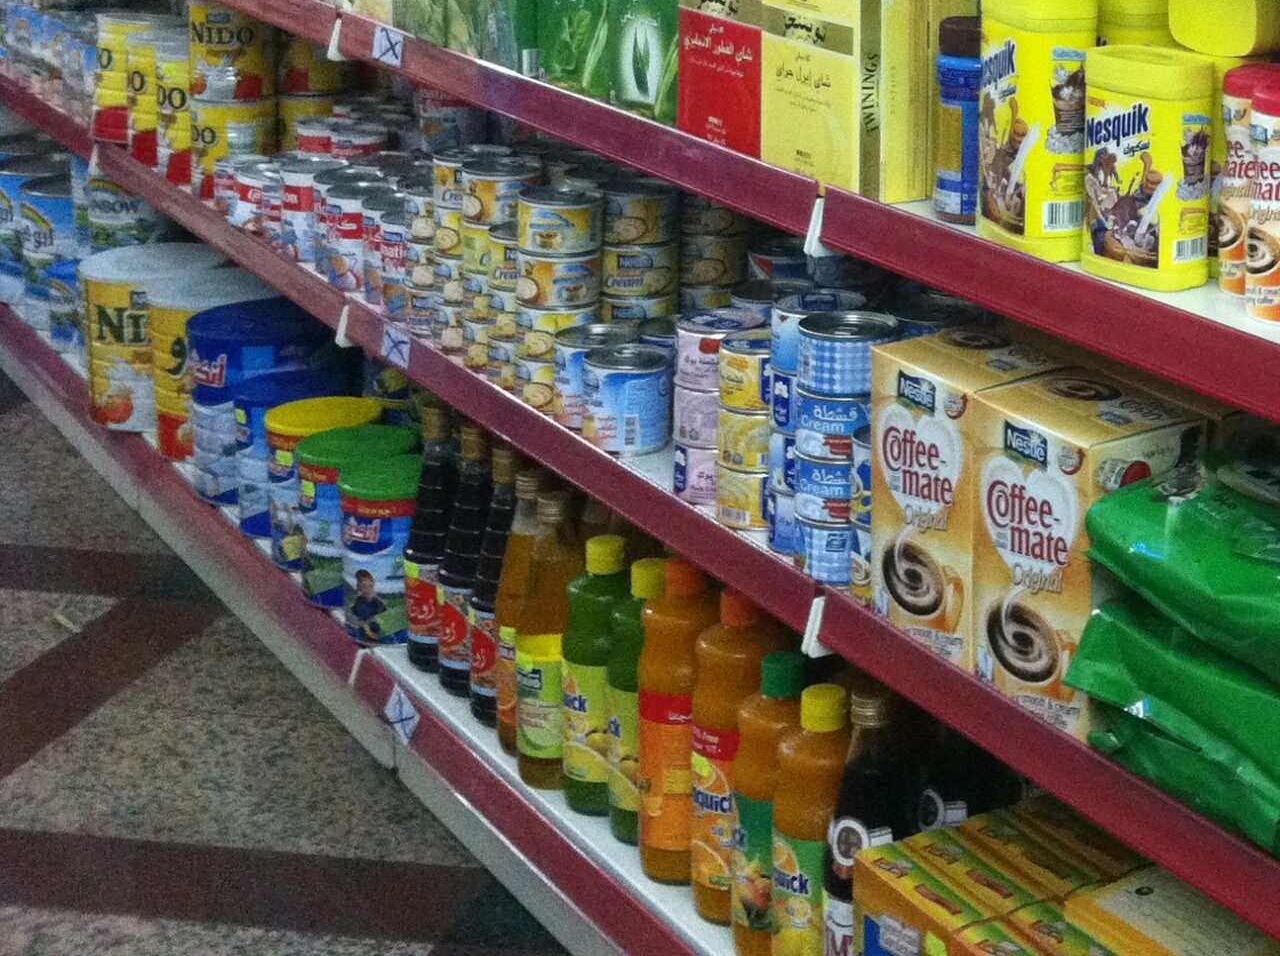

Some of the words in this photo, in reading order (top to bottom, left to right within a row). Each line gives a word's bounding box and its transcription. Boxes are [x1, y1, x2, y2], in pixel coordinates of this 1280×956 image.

[189, 22, 256, 46] NIDO
[862, 51, 882, 137] TWININGS
[1086, 102, 1151, 150] Nesquik
[801, 416, 845, 433] Cream
[812, 403, 858, 423] قشطة
[881, 425, 948, 472] Coffee-
[1005, 432, 1048, 462] Nestlé
[800, 478, 845, 495] Cream
[901, 464, 954, 507] mate
[986, 477, 1061, 530] Coffee-
[1009, 524, 1069, 567] mate
